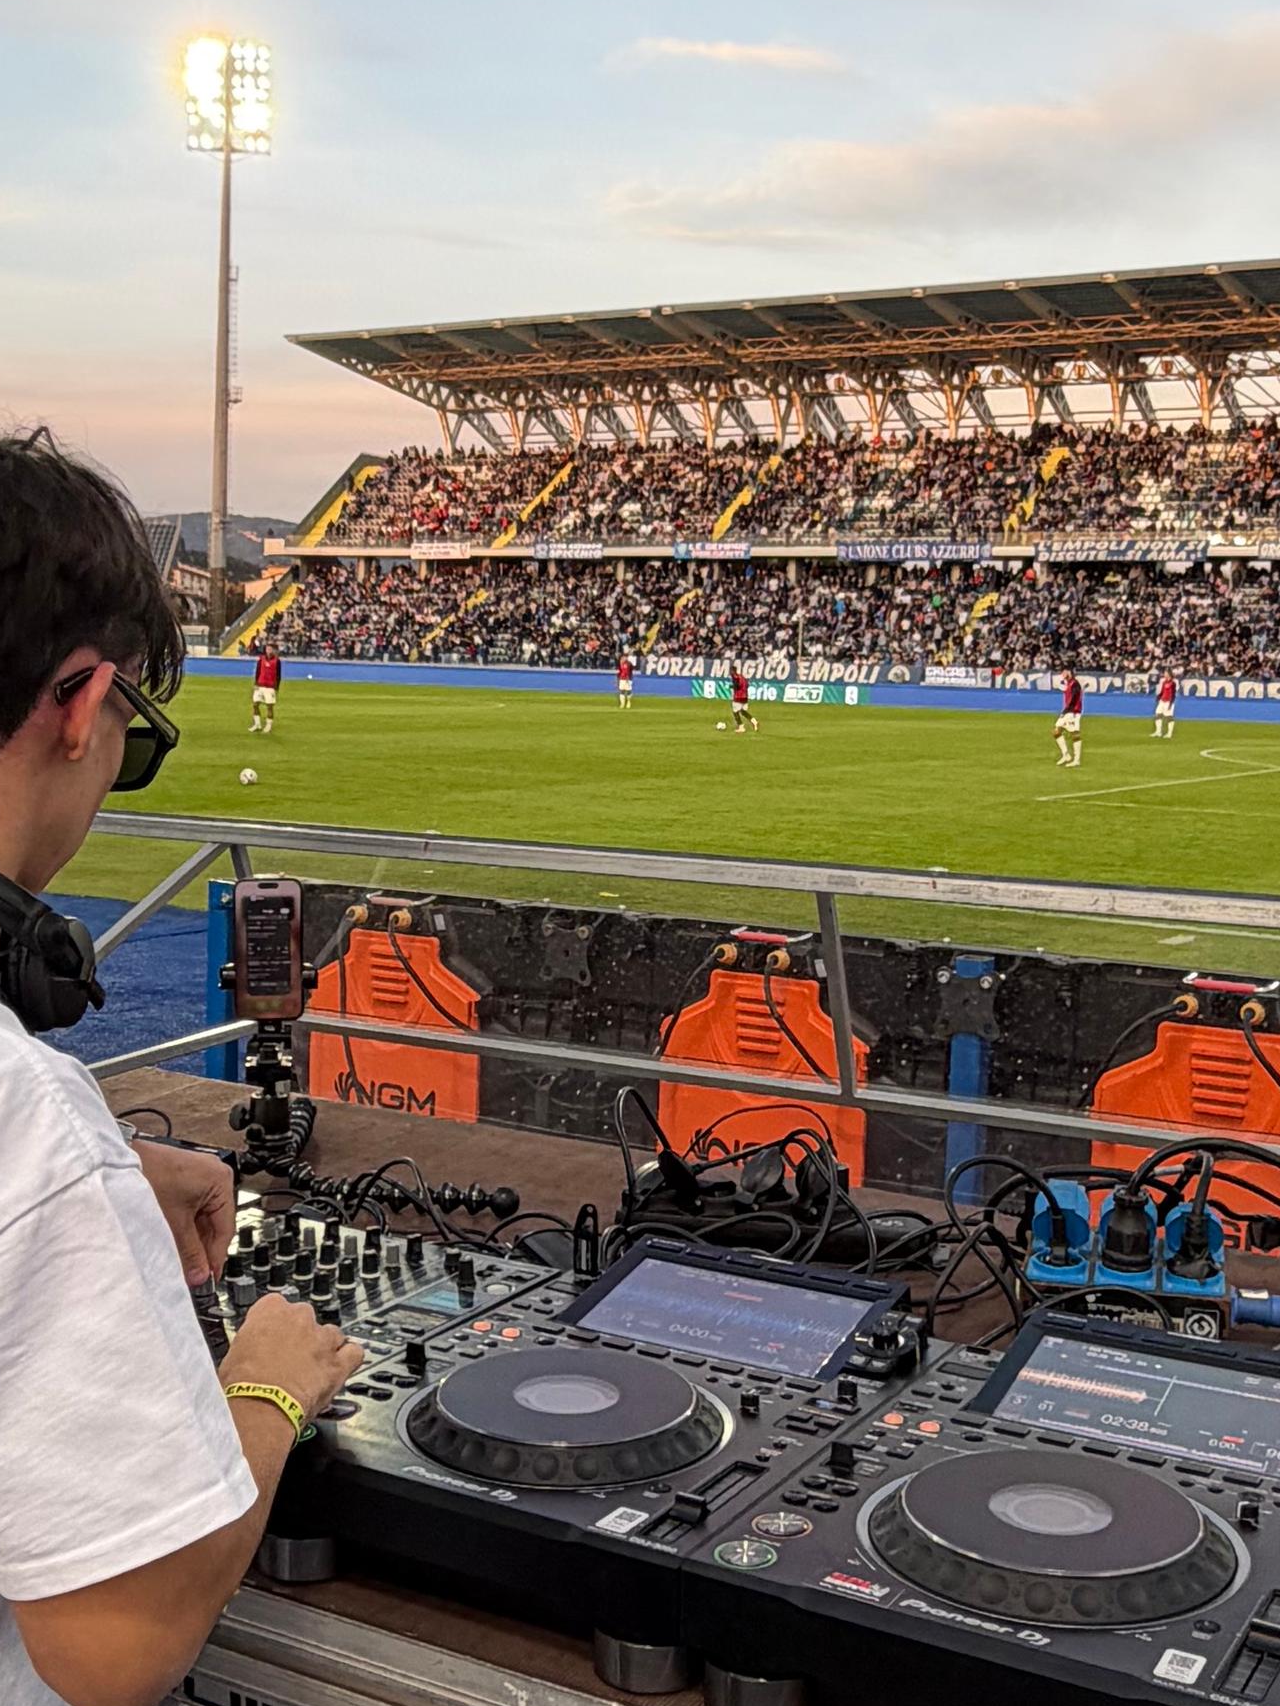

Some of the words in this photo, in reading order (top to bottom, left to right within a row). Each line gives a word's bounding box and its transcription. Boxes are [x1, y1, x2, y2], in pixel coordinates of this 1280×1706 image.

[848, 544, 890, 559] UNIONE
[892, 544, 929, 559] CLUBS
[930, 544, 980, 559] AZZURRI
[1038, 540, 1129, 552] L'EMPOLI
[1134, 540, 1179, 551] NON
[1185, 540, 1208, 551] SI
[645, 654, 705, 677] FORZA
[710, 657, 790, 681] MAGICO
[797, 659, 881, 684] EMPOLI
[226, 1384, 287, 1404] EMPOLI
[899, 1598, 1014, 1633] Pioneer
